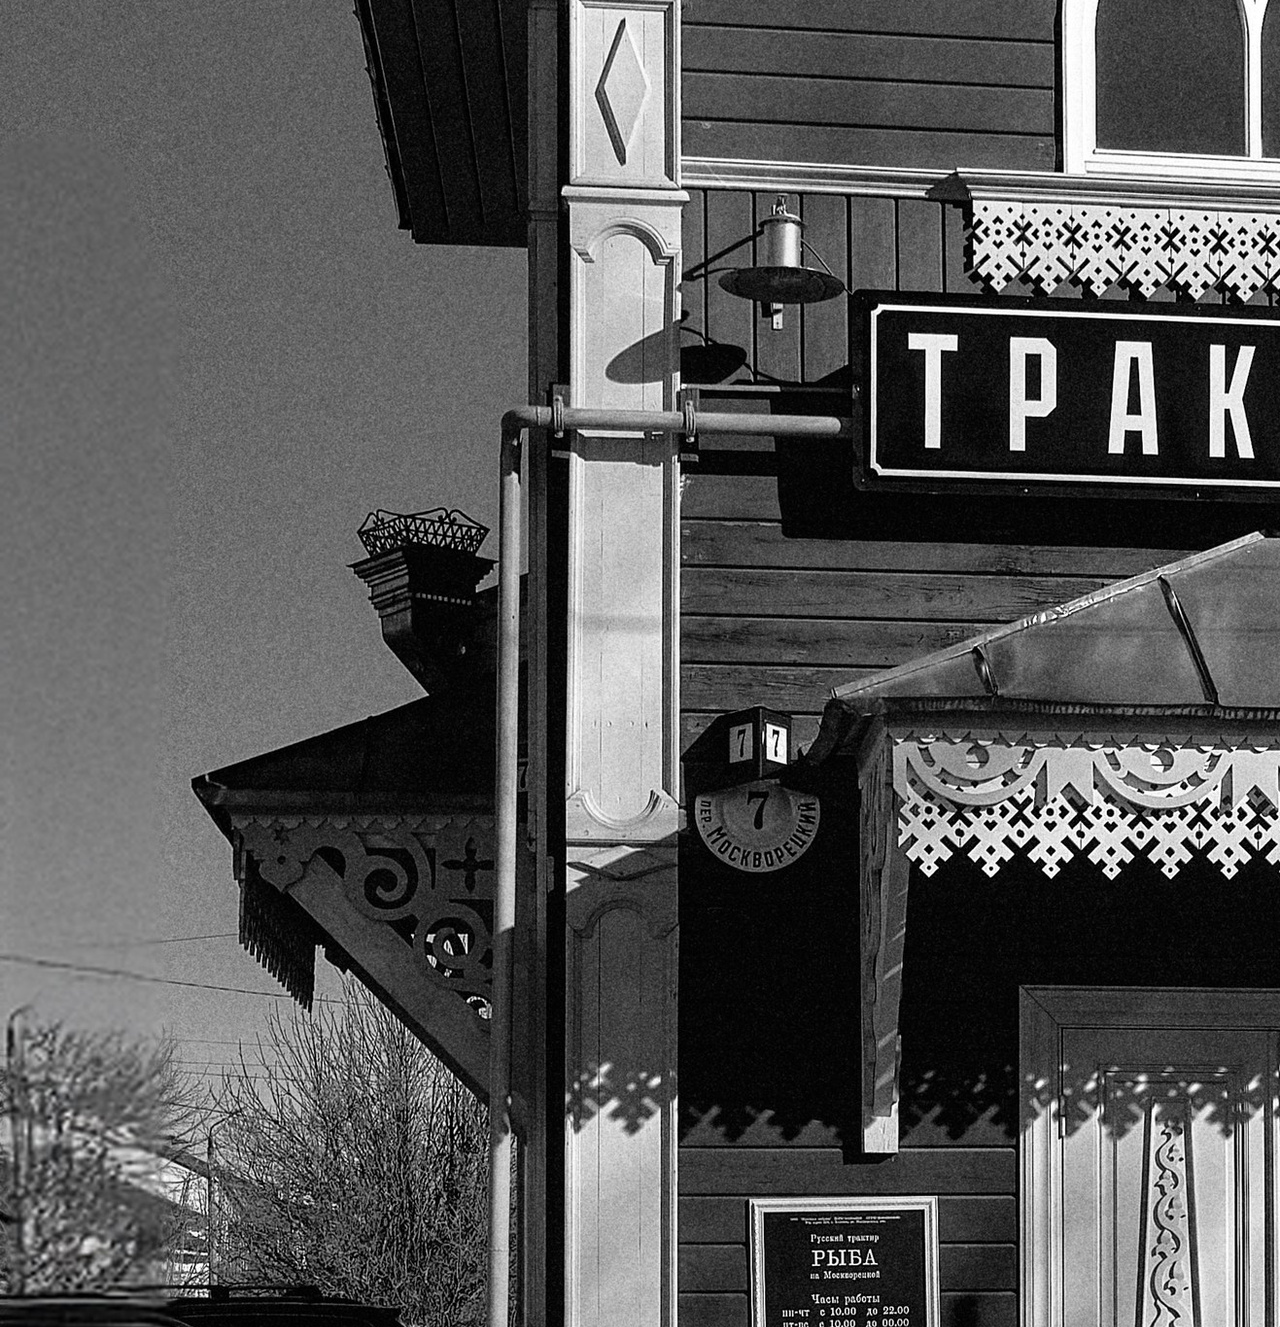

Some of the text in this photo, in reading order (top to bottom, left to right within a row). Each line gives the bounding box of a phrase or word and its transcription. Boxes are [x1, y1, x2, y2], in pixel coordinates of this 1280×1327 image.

[737, 729, 747, 758] 7
[772, 729, 780, 758] 7
[747, 790, 770, 830] 7
[700, 800, 817, 868] ПЕР. МОСКВОРЕЦКИЙ
[810, 1234, 880, 1244] Русский трактир
[811, 1249, 878, 1267] РЫБА
[823, 1270, 881, 1281] Москворецкой
[811, 1293, 880, 1305] Часы работы
[782, 1306, 910, 1317] пн-чт с 10.00 до 22.00
[882, 1318, 910, 1327] 00.00
